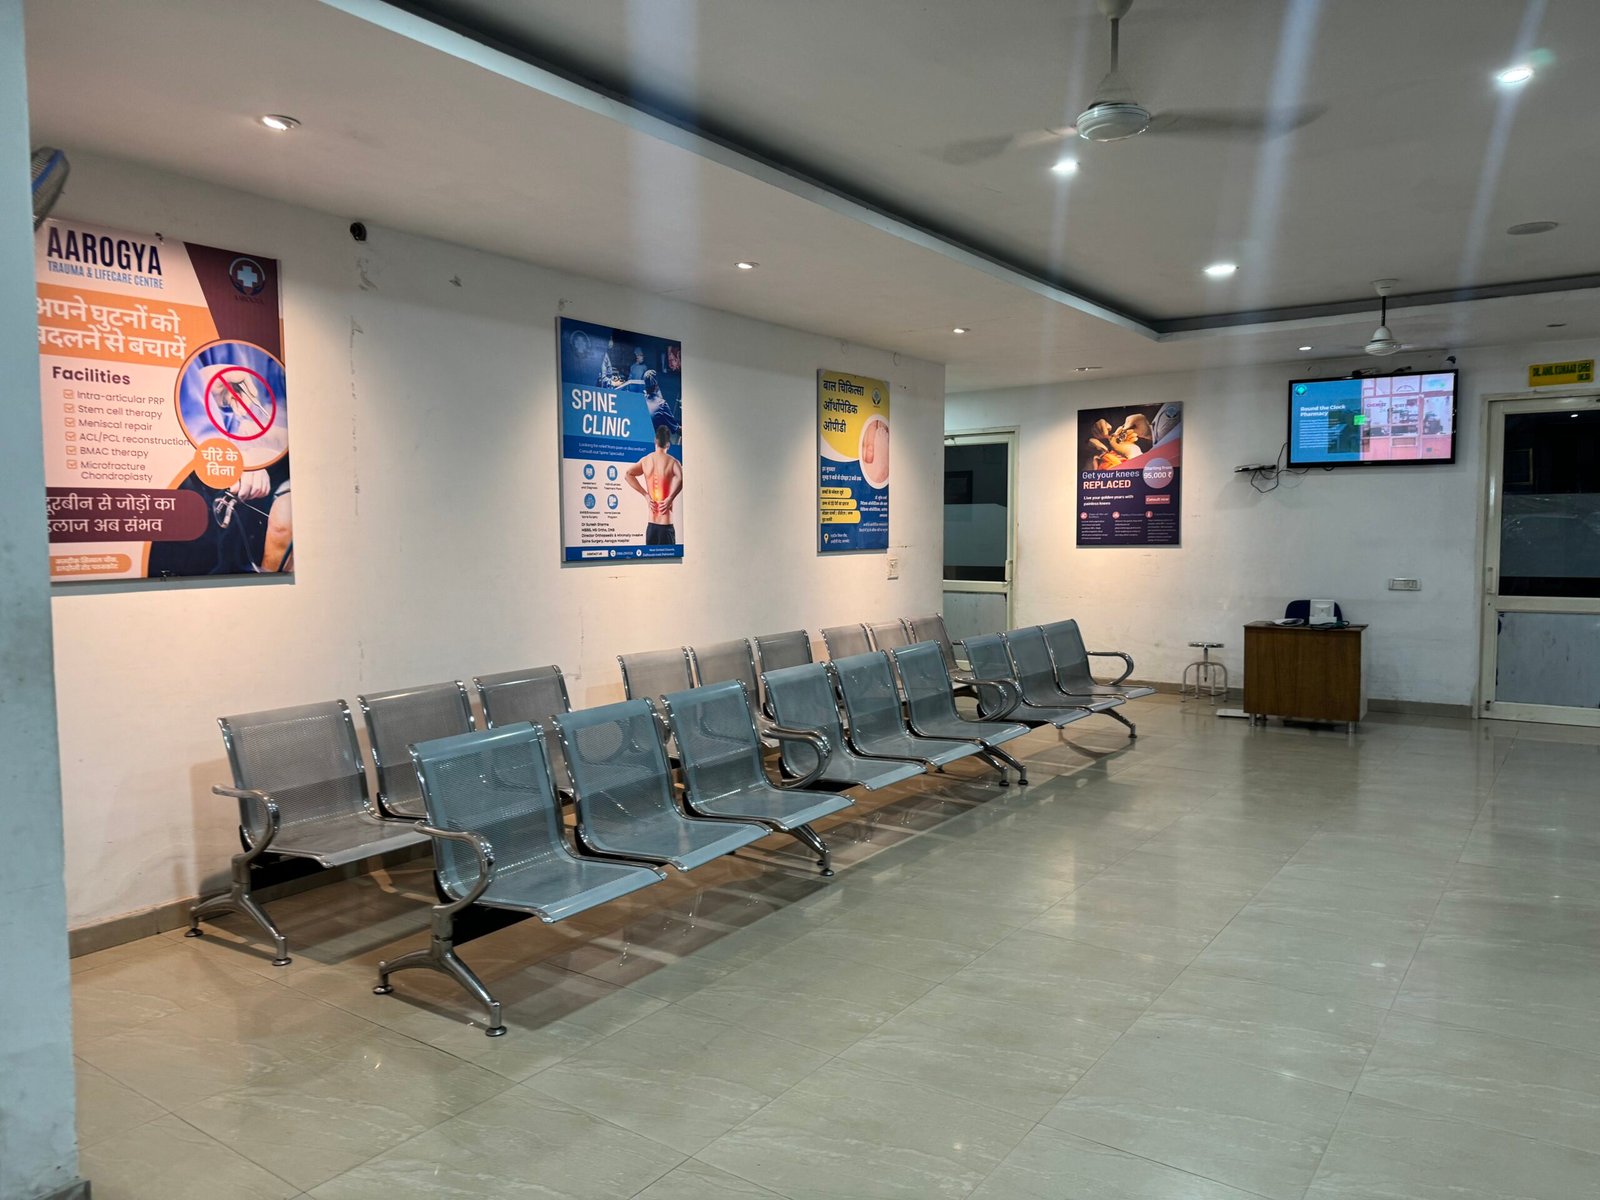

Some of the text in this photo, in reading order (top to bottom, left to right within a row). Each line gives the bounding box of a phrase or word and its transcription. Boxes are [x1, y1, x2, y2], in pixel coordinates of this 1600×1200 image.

[47, 226, 162, 276] AAROGYA
[47, 260, 164, 290] TRAUMA & LIFECARE CENTRE
[91, 304, 148, 331] घुटनों
[151, 309, 181, 335] को
[103, 327, 126, 353] से
[128, 335, 187, 360] बचायें
[52, 366, 131, 385] Facilities
[823, 379, 864, 396] बाल चिकित्सा
[76, 390, 165, 406] Intra-articular PRP
[571, 388, 618, 414] SPINE
[78, 404, 163, 420] Stem cell therapy
[1300, 410, 1329, 418] Pharmacy
[78, 419, 153, 432] Meniscal repair
[582, 413, 631, 438] CLINIC
[823, 417, 846, 433] ओपीडी
[79, 432, 189, 447] ACL/PCL reconstruction
[80, 447, 149, 459] BMAC therapy
[200, 446, 239, 462] चीरे के
[81, 460, 146, 472] Microfracture
[206, 462, 235, 477] बिना
[81, 471, 153, 483] Chondroplasty
[1082, 470, 1140, 480] Get your knees
[1083, 479, 1131, 490] REPLACED
[98, 495, 113, 511] से
[116, 493, 151, 513] जोड़ों
[154, 496, 176, 511] का
[94, 518, 120, 532] अब
[123, 515, 163, 532] संभव
